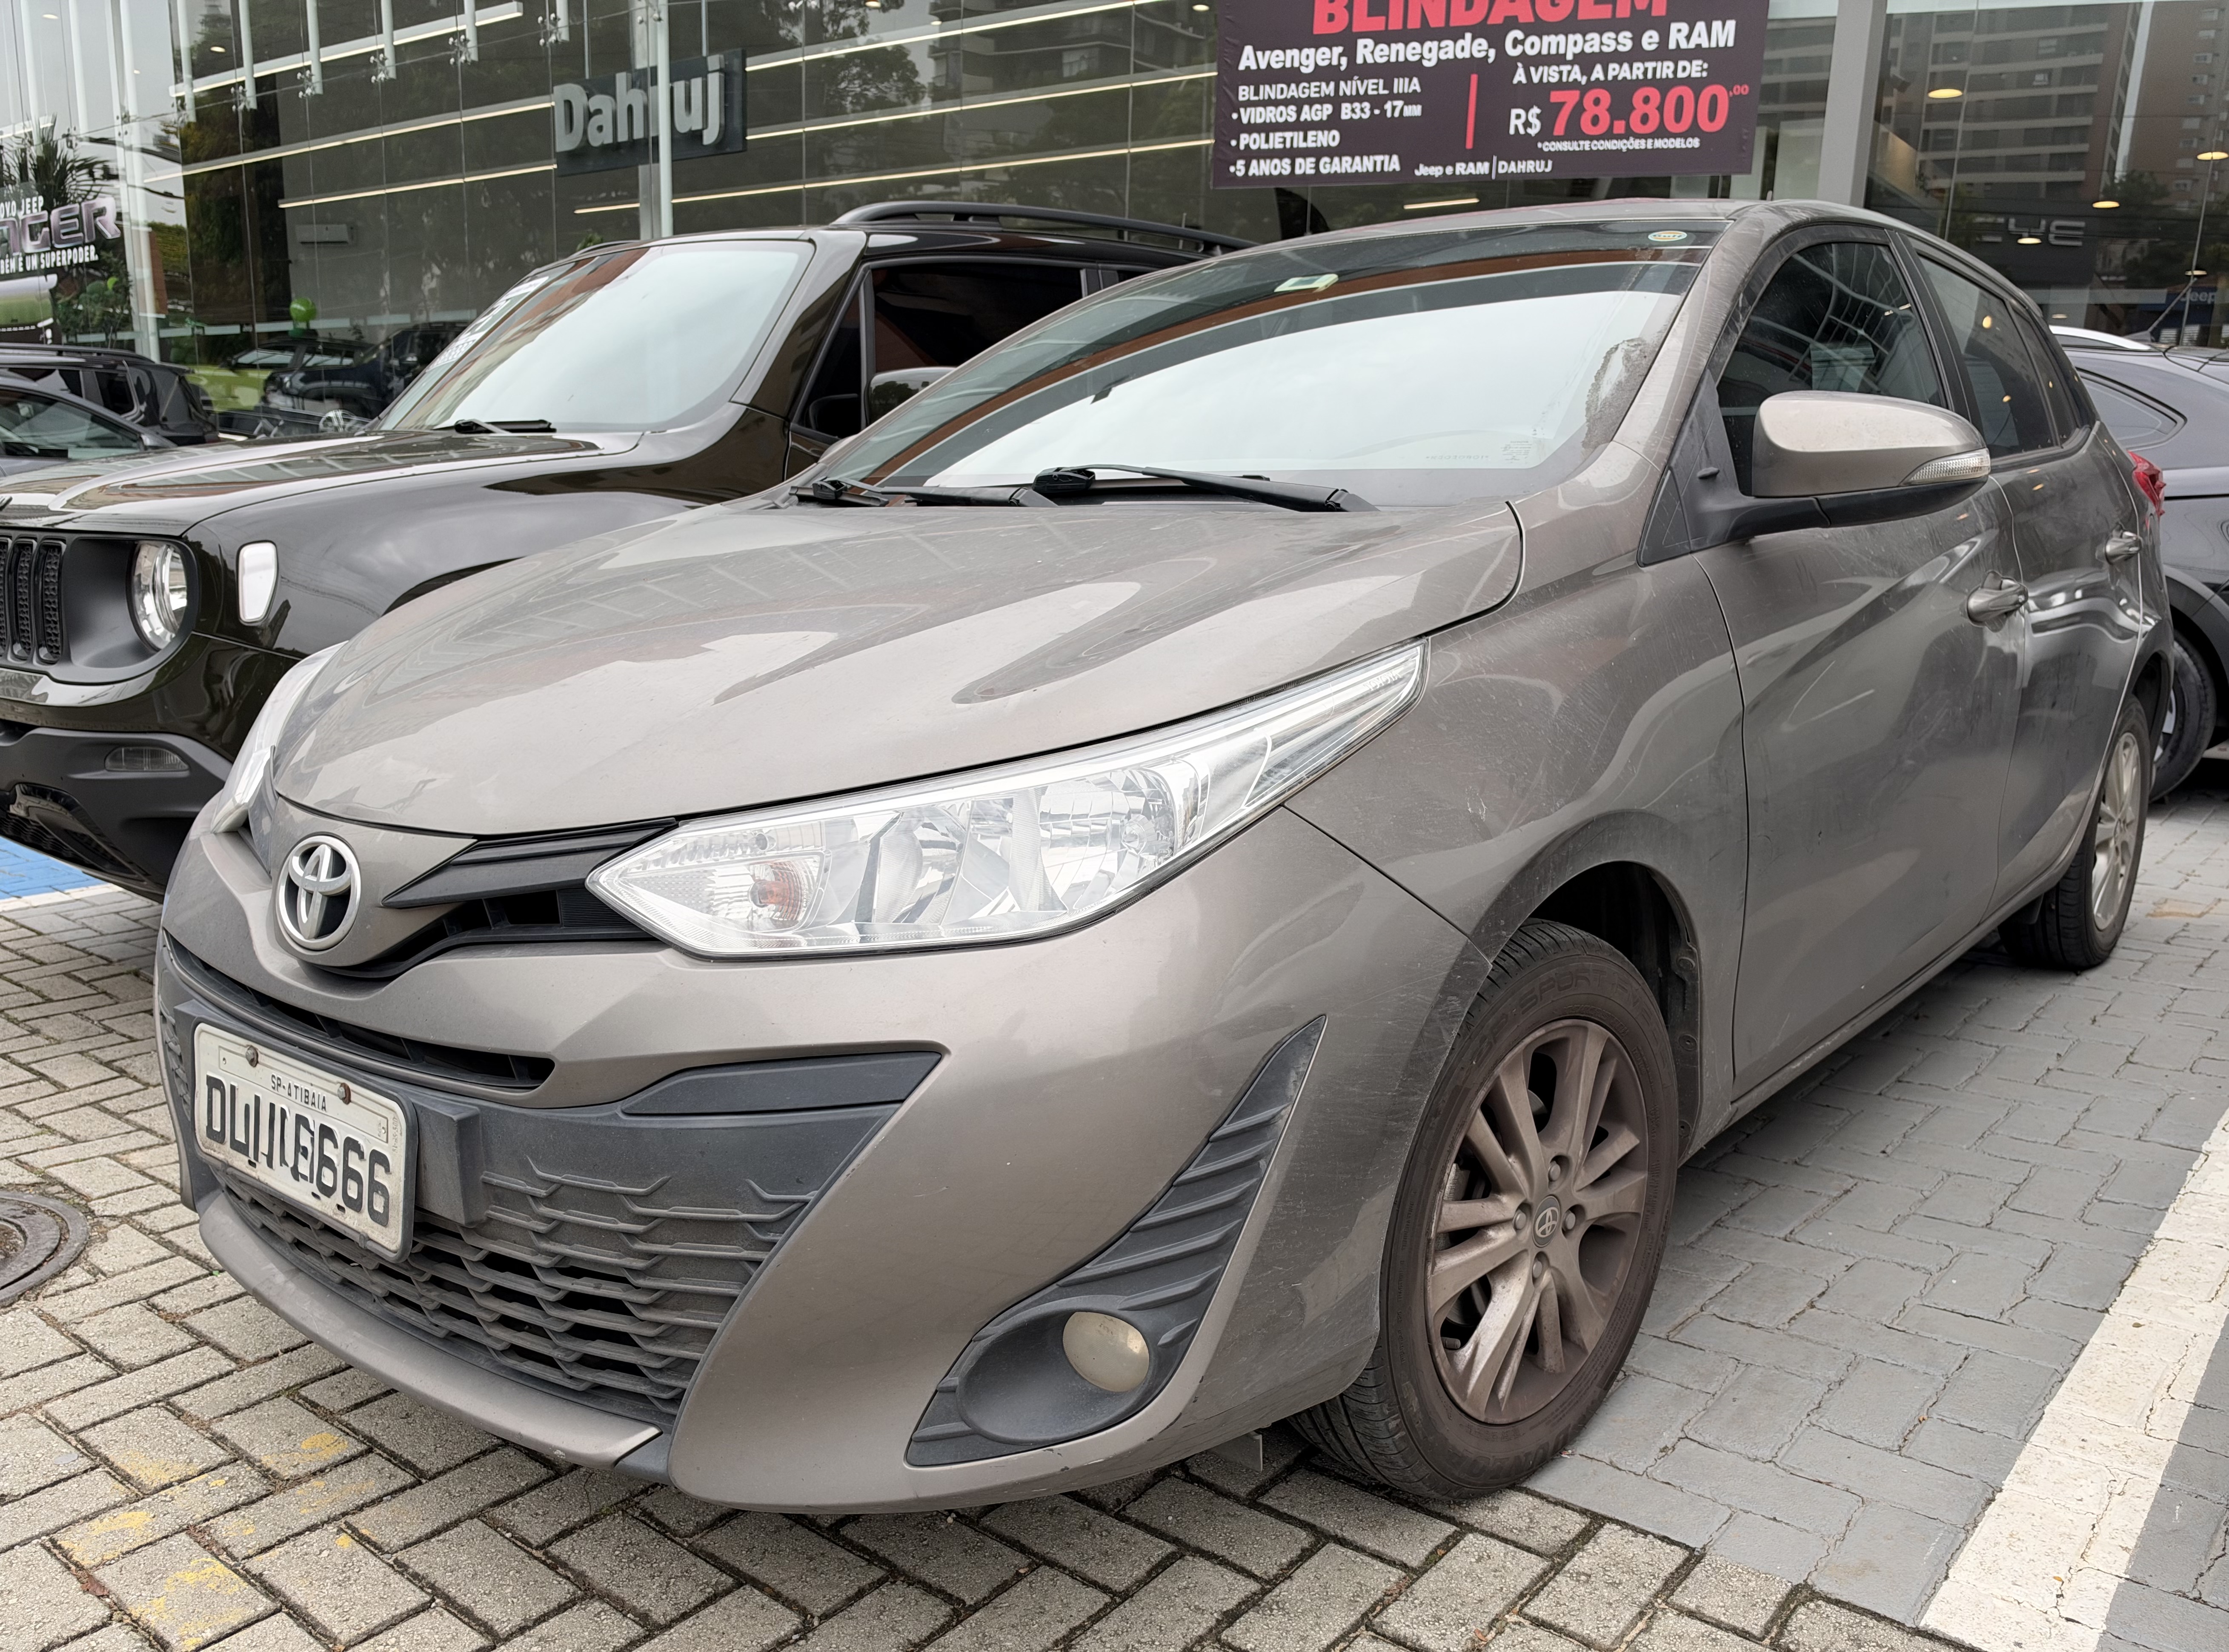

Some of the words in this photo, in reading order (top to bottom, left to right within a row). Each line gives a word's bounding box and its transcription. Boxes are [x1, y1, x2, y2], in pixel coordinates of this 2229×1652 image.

[1238, 45, 1348, 73] Avenger,
[1356, 32, 1496, 67] Renegade,
[1505, 29, 1633, 60] Compass
[1642, 30, 1660, 51] e
[1668, 20, 1736, 49] RAM
[1513, 62, 1527, 84] À
[1530, 64, 1587, 85] VISTA,
[1591, 63, 1605, 81] A
[1608, 61, 1675, 80] PARTIR
[1677, 60, 1708, 78] DE:
[1238, 82, 1335, 101] BLINDAGEM
[1339, 76, 1389, 96] NÍVEL
[1393, 77, 1421, 94] IIIA
[1239, 106, 1297, 124] VIDROS
[1300, 104, 1333, 121] AGP
[1340, 102, 1371, 120] B33
[1509, 106, 1542, 136] R$
[1239, 130, 1340, 150] POLIETILENO
[1591, 137, 1646, 152] CONDIÇÕES
[1647, 139, 1654, 149] E
[1654, 137, 1700, 149] MODELOS
[1248, 158, 1291, 176] ANOS
[1295, 157, 1316, 174] DE
[1319, 154, 1401, 174] GARANTIA
[1414, 163, 1444, 177] Jeep
[1445, 166, 1454, 175] e
[1455, 162, 1490, 175] RAM
[1498, 160, 1553, 174] DAHRUJ
[20, 196, 44, 215] JEEP
[40, 245, 98, 269] SUPERPODER.
